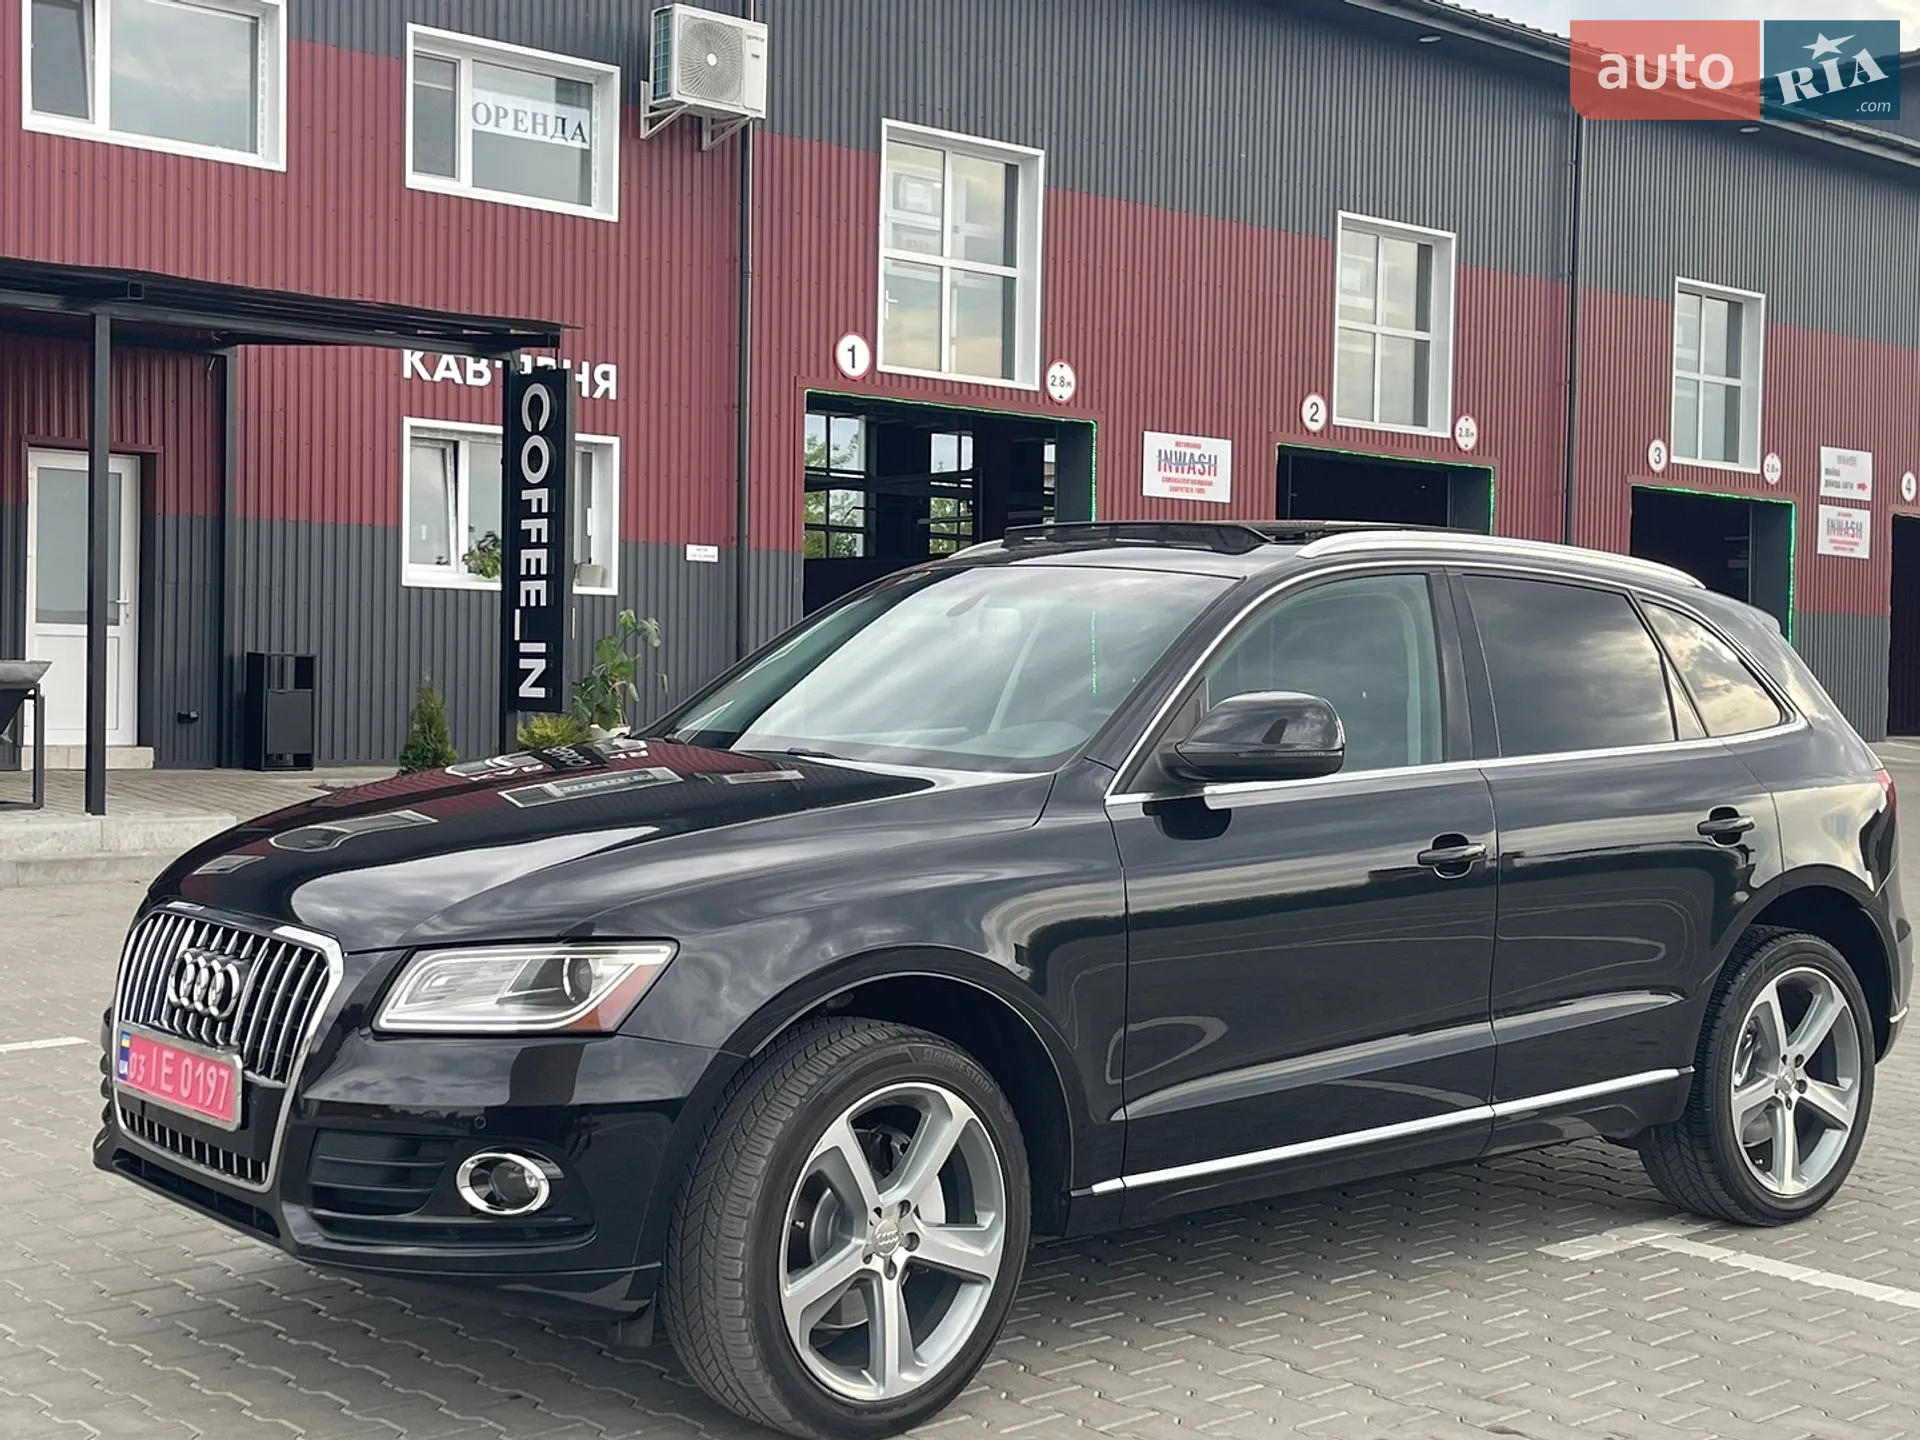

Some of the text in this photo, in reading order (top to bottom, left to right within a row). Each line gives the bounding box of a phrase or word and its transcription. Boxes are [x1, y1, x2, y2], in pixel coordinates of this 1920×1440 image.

[471, 101, 588, 143] ОРЕНДА
[847, 344, 856, 369] 1
[1309, 401, 1320, 423] 2
[1157, 448, 1218, 477] INWASH
[1654, 446, 1663, 464] 3
[1905, 477, 1912, 494] 4
[180, 1056, 230, 1111] 0197
